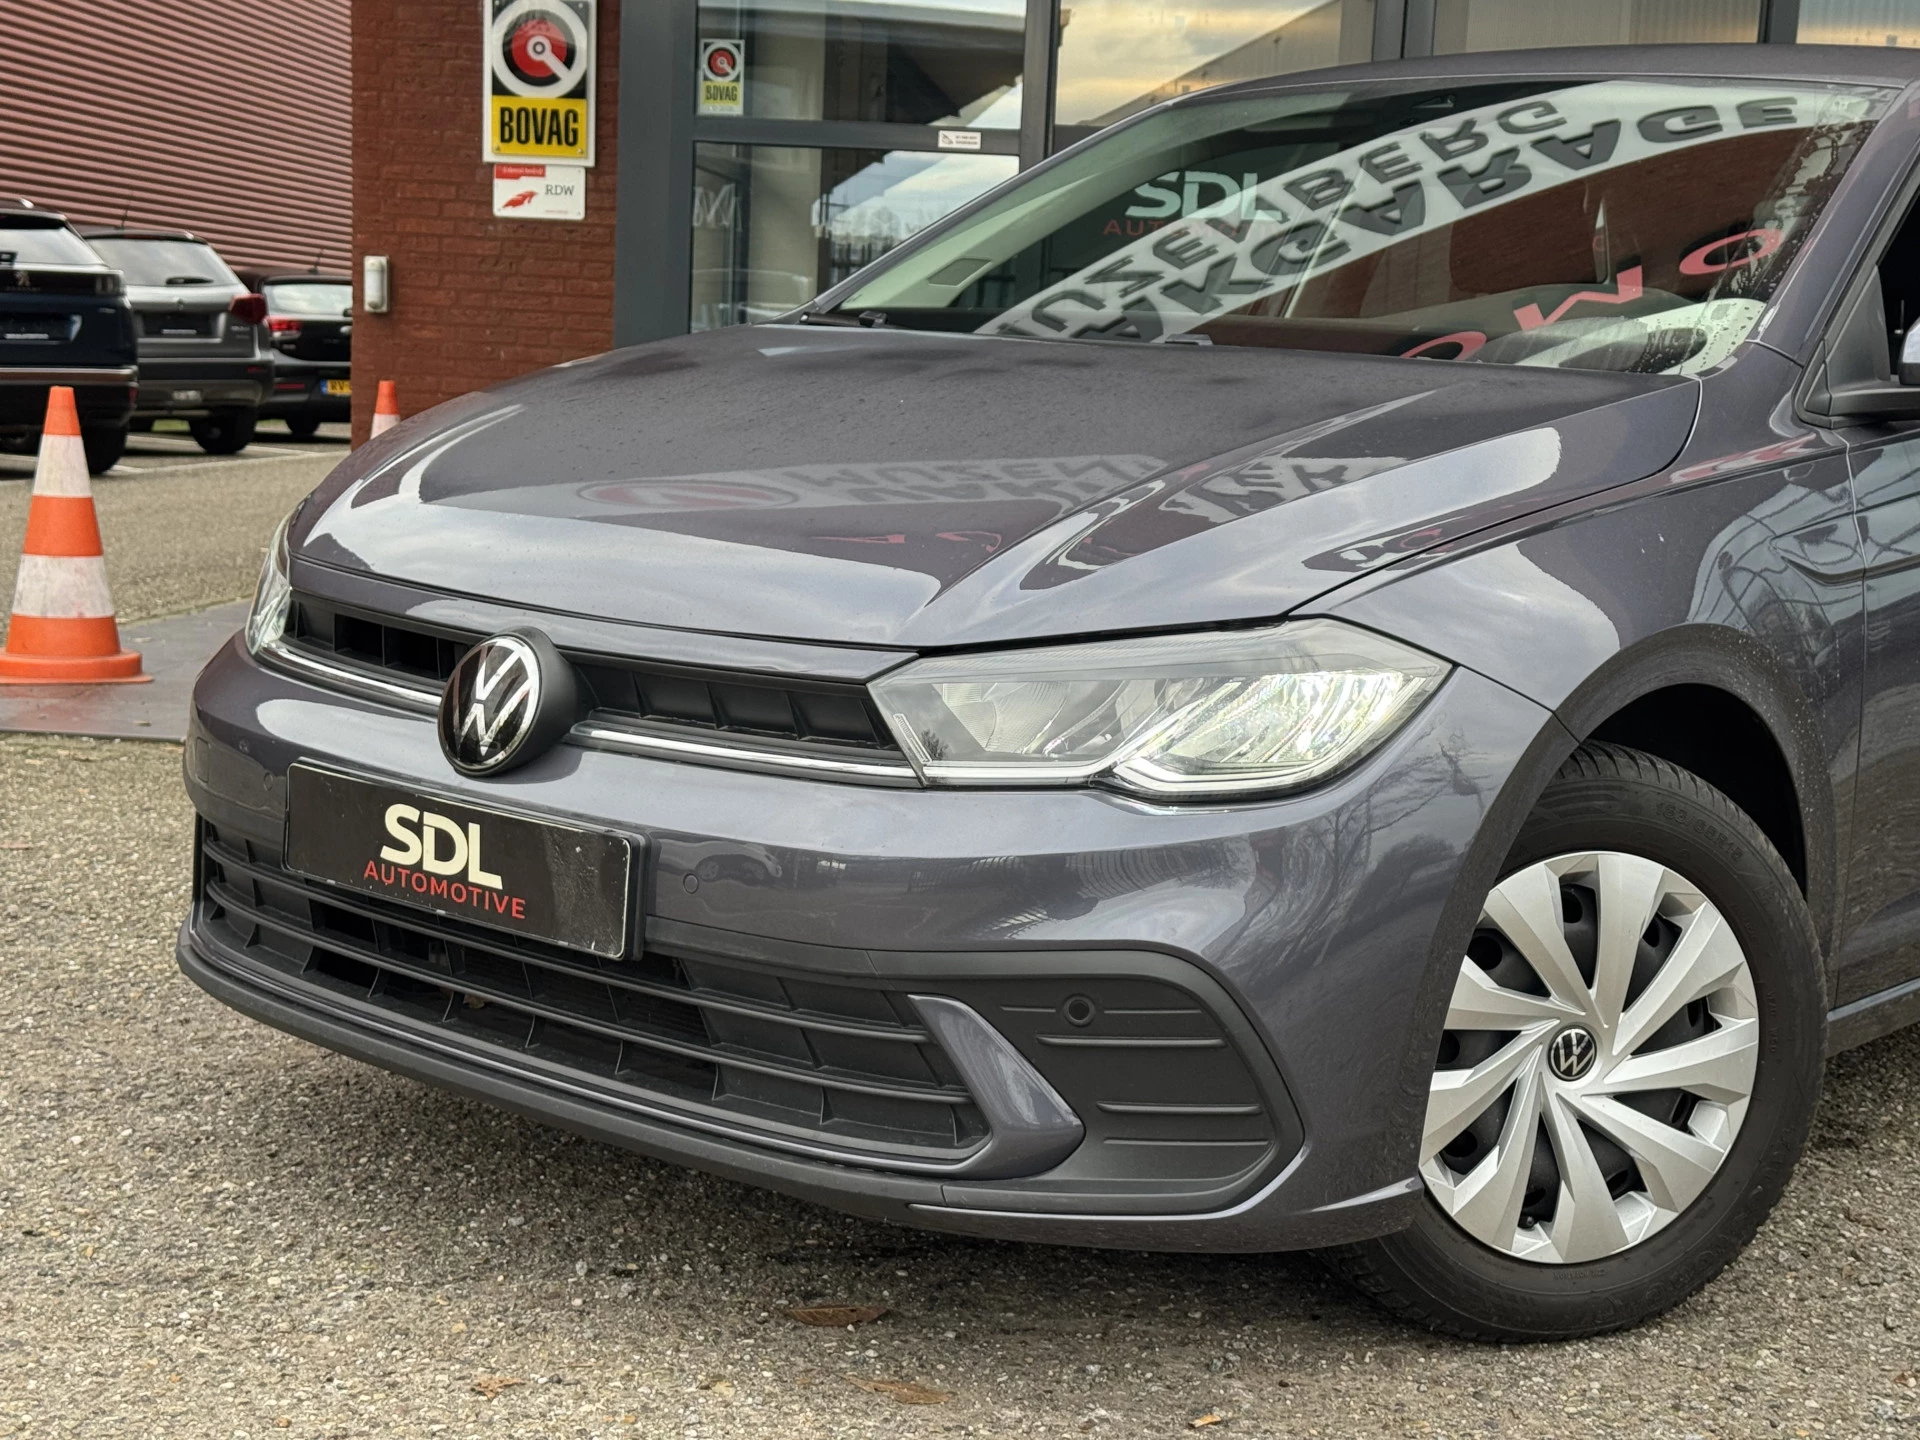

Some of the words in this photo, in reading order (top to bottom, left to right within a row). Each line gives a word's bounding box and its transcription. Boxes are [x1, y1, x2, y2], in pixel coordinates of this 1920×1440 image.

[705, 84, 738, 101] BOVAG
[500, 107, 579, 147] BOVAG
[544, 184, 575, 197] RDW
[380, 803, 503, 890] SDL
[363, 860, 526, 920] AUTOMOTIVE
